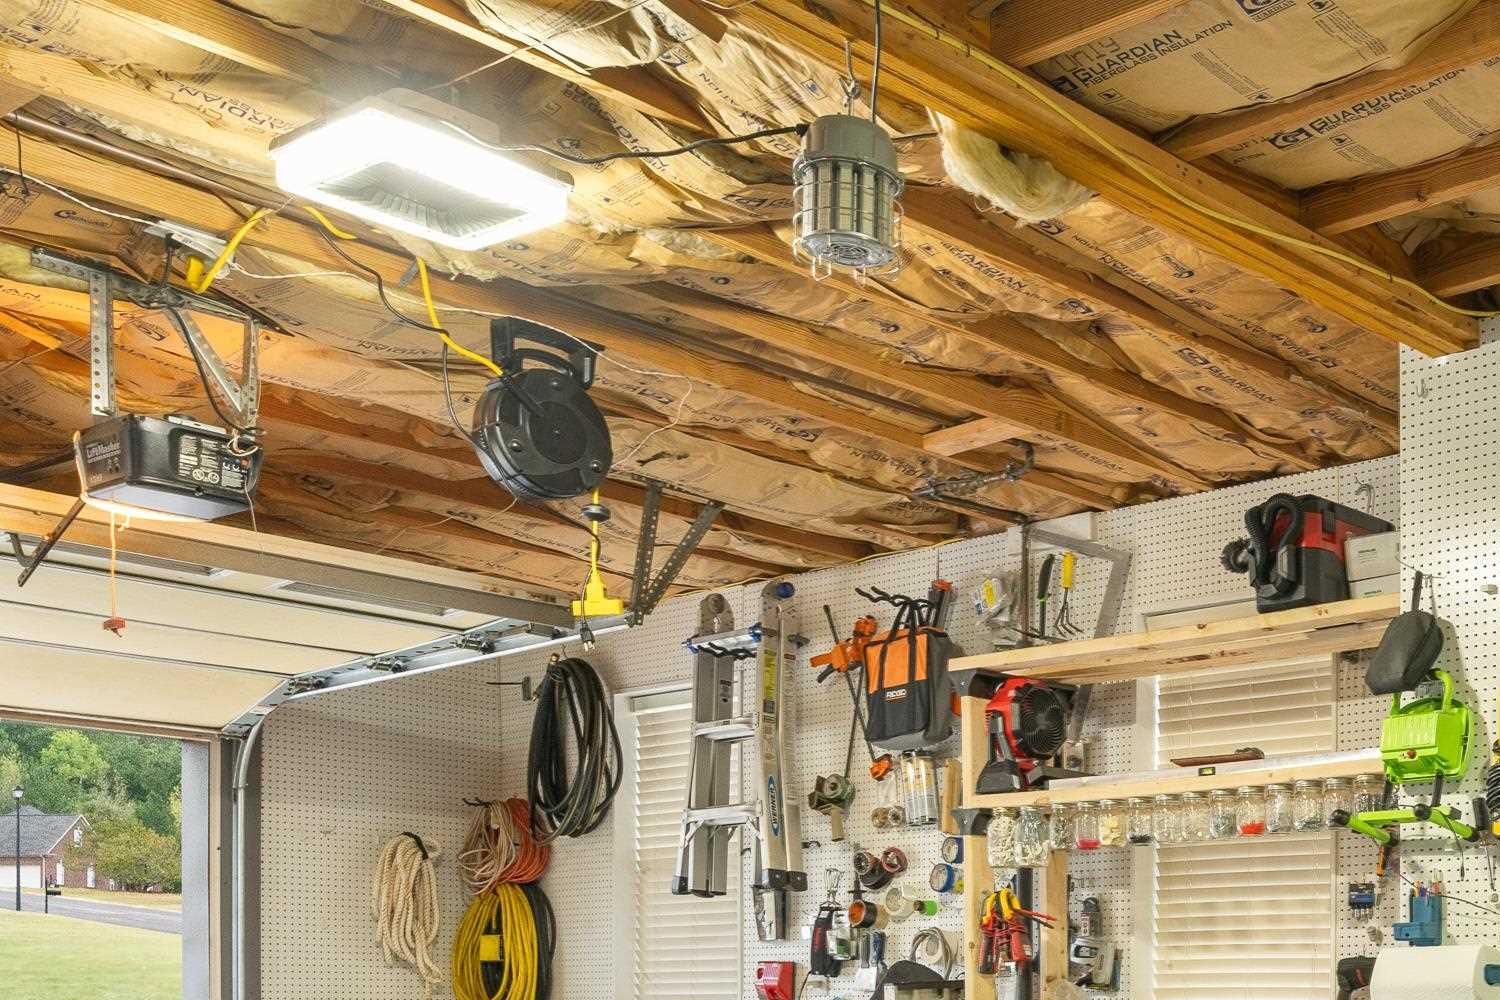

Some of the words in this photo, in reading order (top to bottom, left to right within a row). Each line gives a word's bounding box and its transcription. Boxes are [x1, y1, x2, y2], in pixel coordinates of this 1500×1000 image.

[1073, 29, 1182, 81] GUARDIAN
[1081, 53, 1156, 89] FIBERGLASS
[1159, 19, 1233, 55] INSULATION
[768, 786, 778, 825] WERNER
